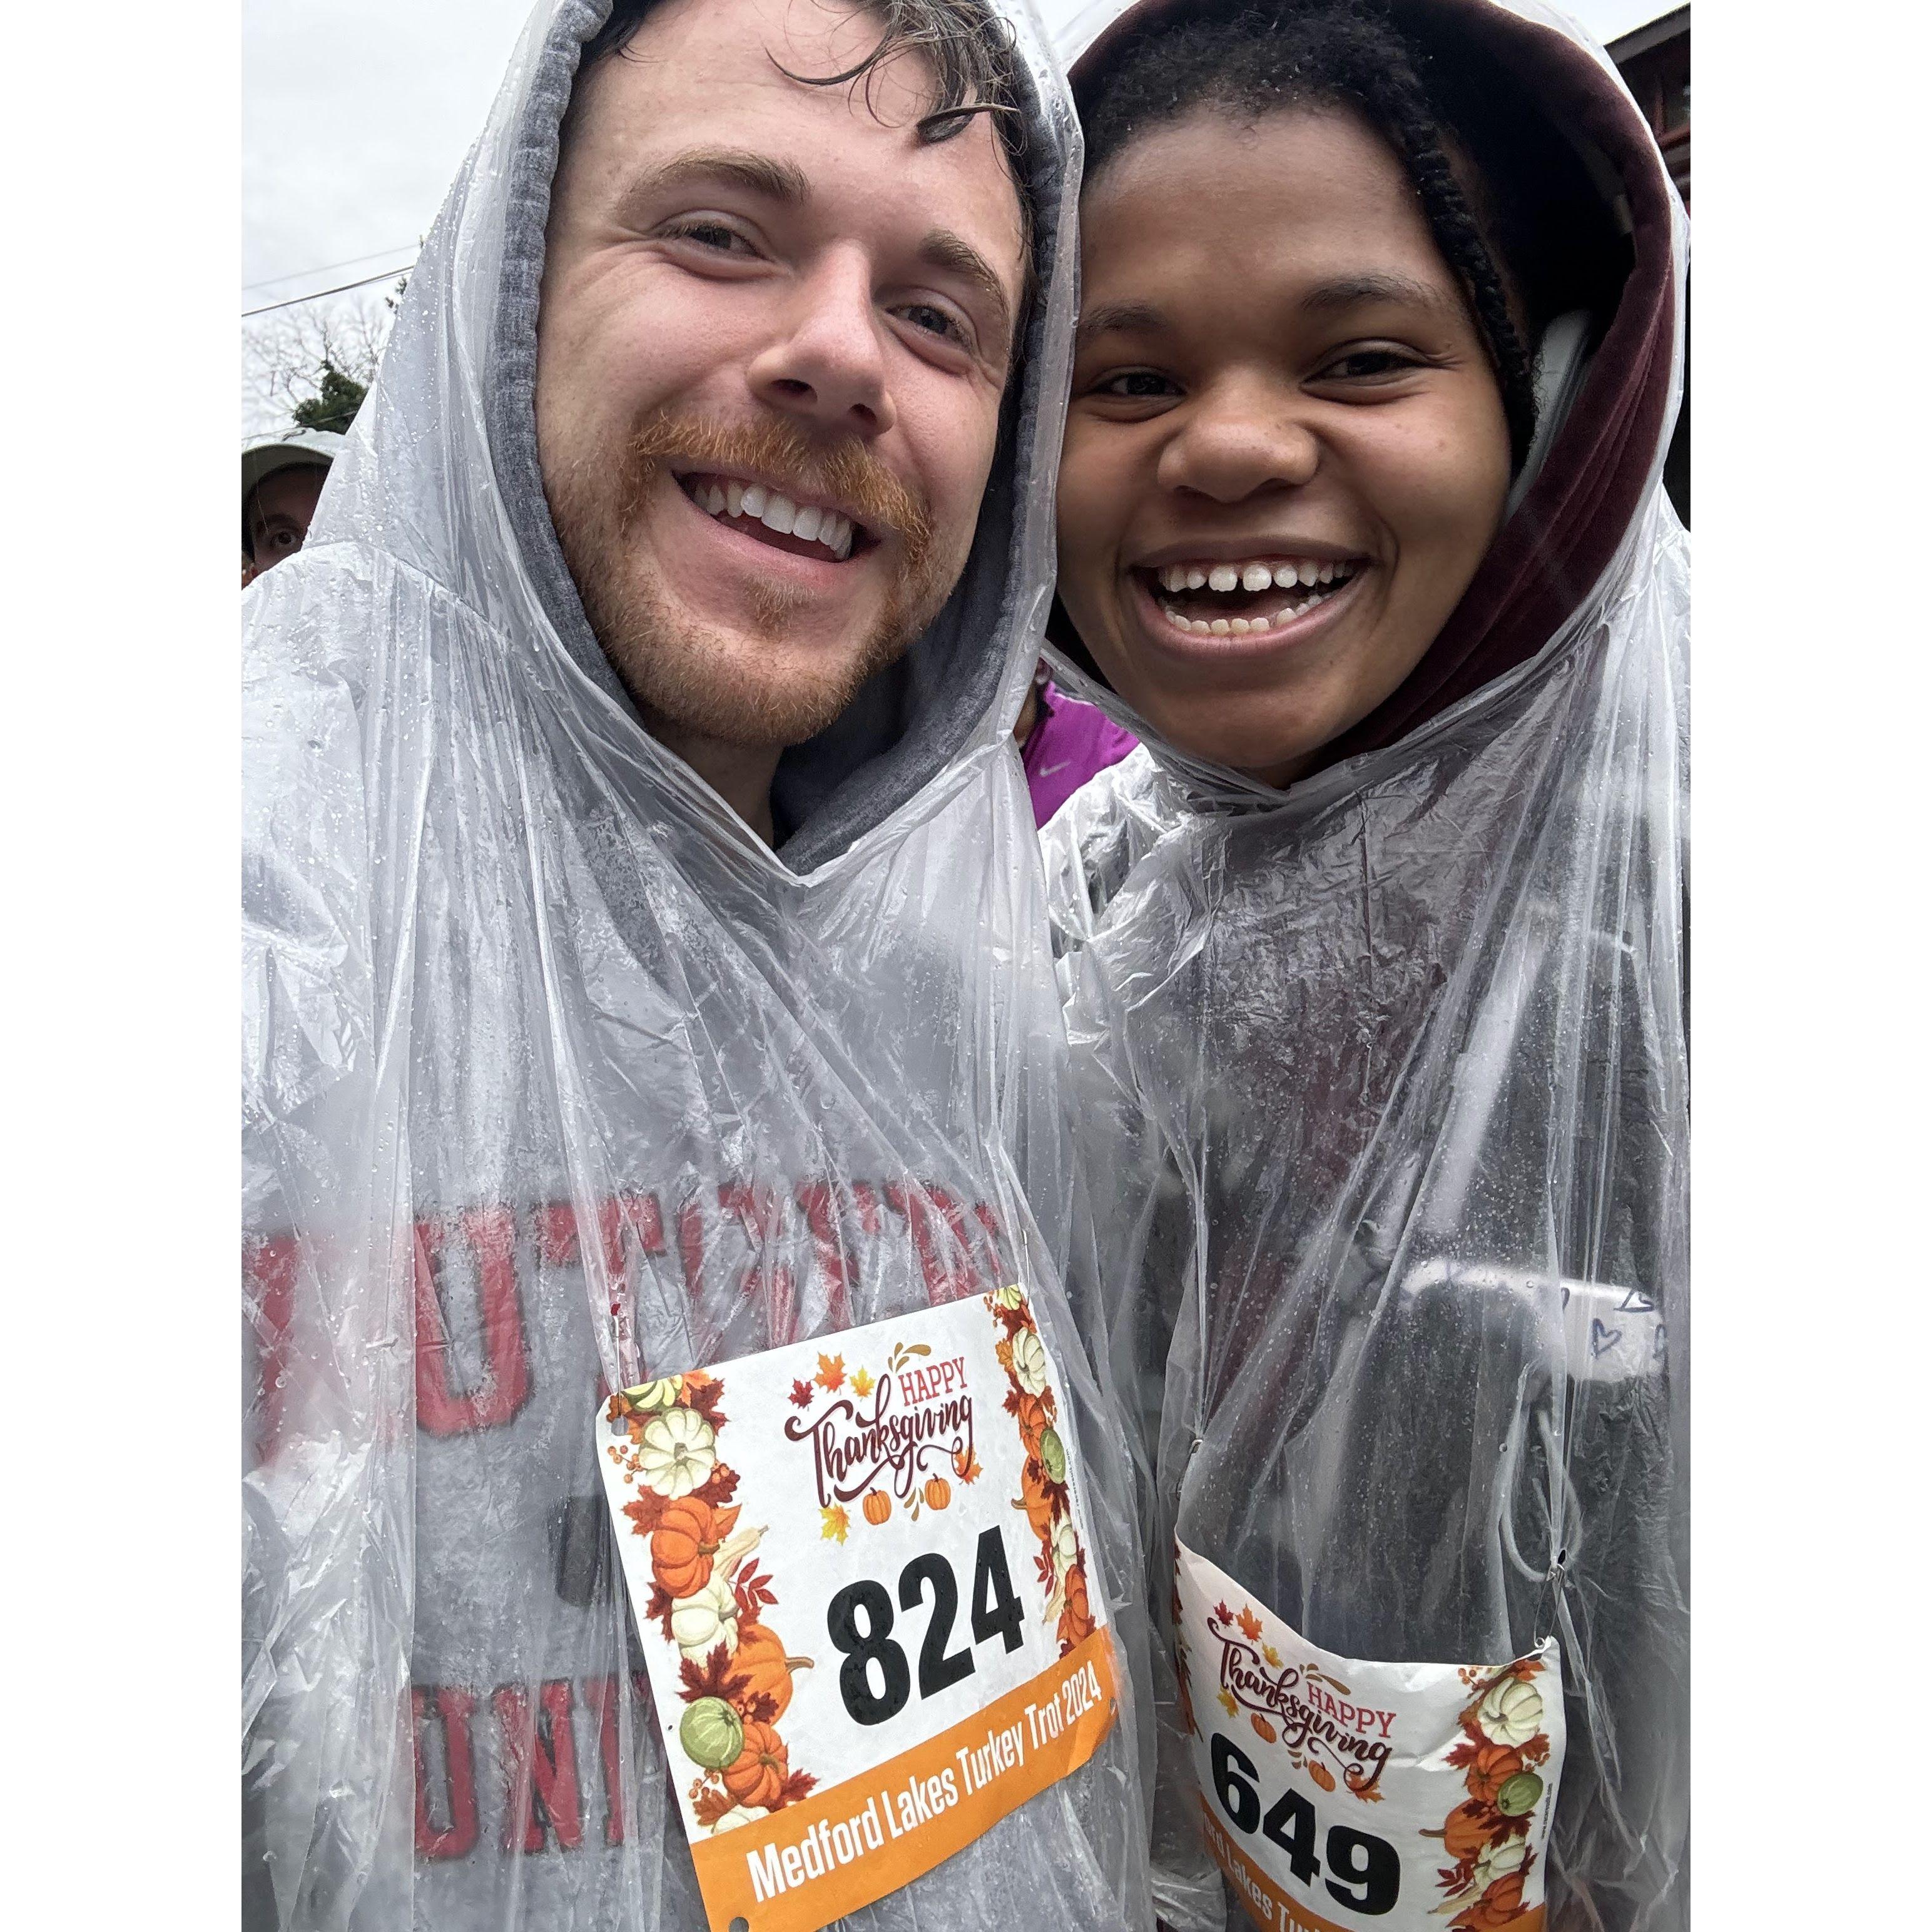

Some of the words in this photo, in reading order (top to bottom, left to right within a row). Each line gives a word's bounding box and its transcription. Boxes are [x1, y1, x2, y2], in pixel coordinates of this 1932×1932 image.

[784, 1373, 973, 1508] Thanksgiving
[898, 1356, 968, 1407] HAPPY
[826, 1525, 1025, 1727] 824
[745, 1796, 885, 1903] Medford
[881, 1767, 958, 1839] Lakes
[955, 1721, 1024, 1796] Turkey
[1024, 1692, 1065, 1751] Trot
[1061, 1659, 1102, 1726] 2024
[1207, 1617, 1393, 1791] Thanksgiving
[1308, 1684, 1396, 1739] HAPPY
[1210, 1732, 1401, 1916] 649
[1226, 1841, 1273, 1920] Lakes
